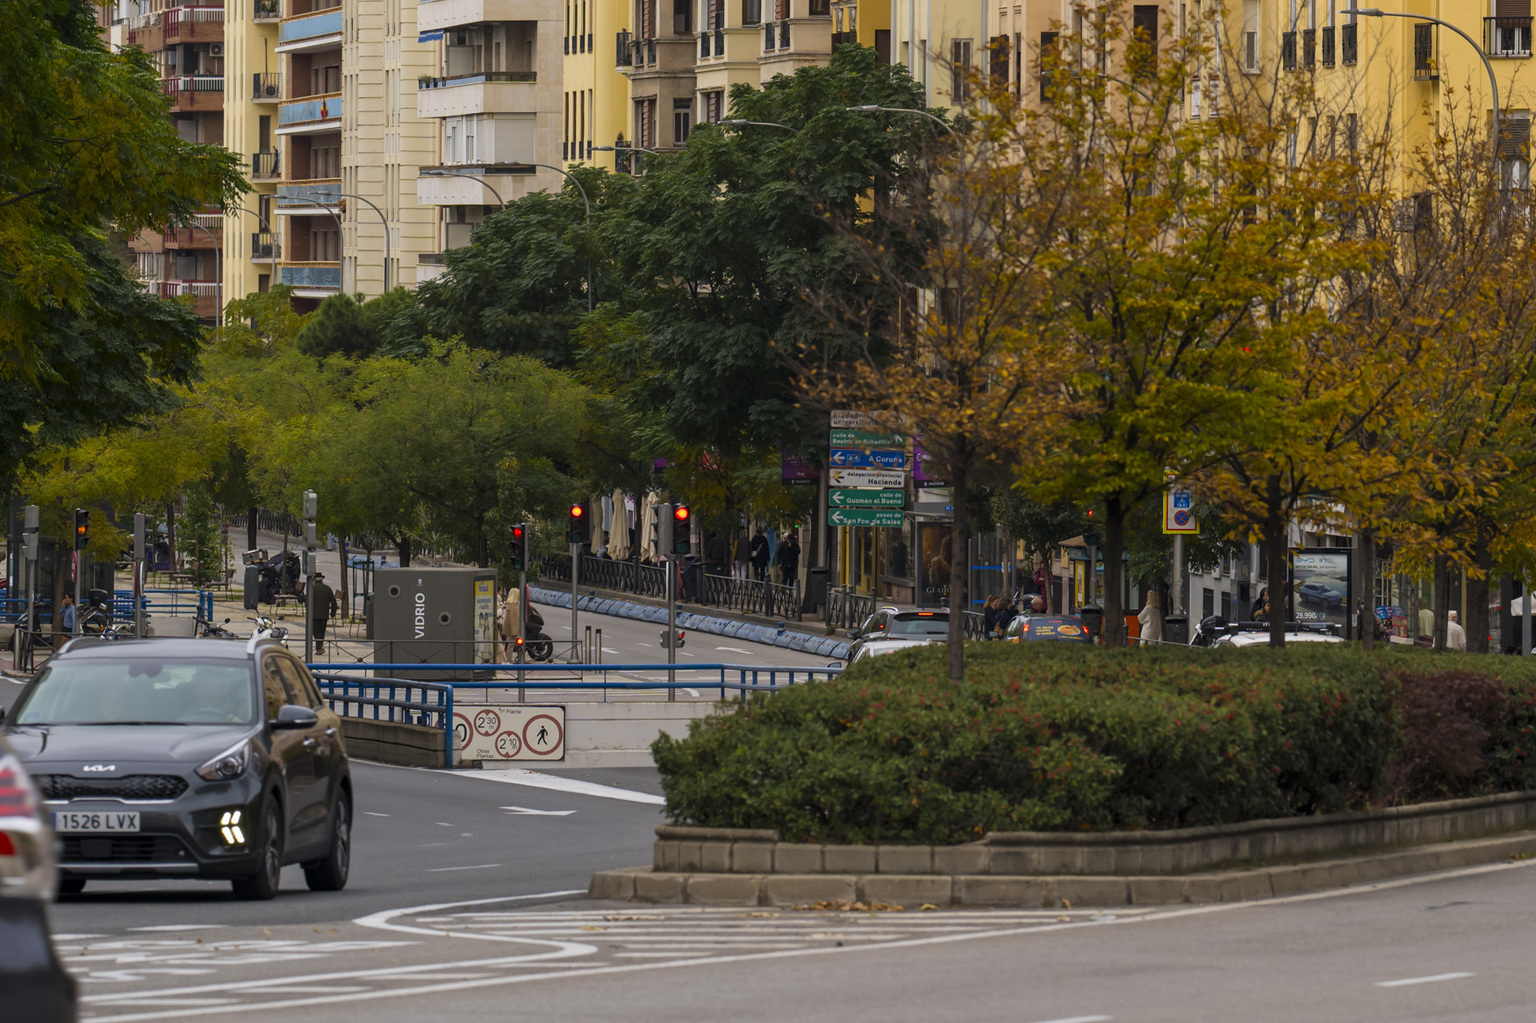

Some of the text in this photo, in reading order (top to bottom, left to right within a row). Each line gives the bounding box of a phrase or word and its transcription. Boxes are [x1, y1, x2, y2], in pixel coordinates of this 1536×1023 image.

[415, 593, 425, 639] VIDRIO
[62, 814, 137, 829] 1526 LVX
